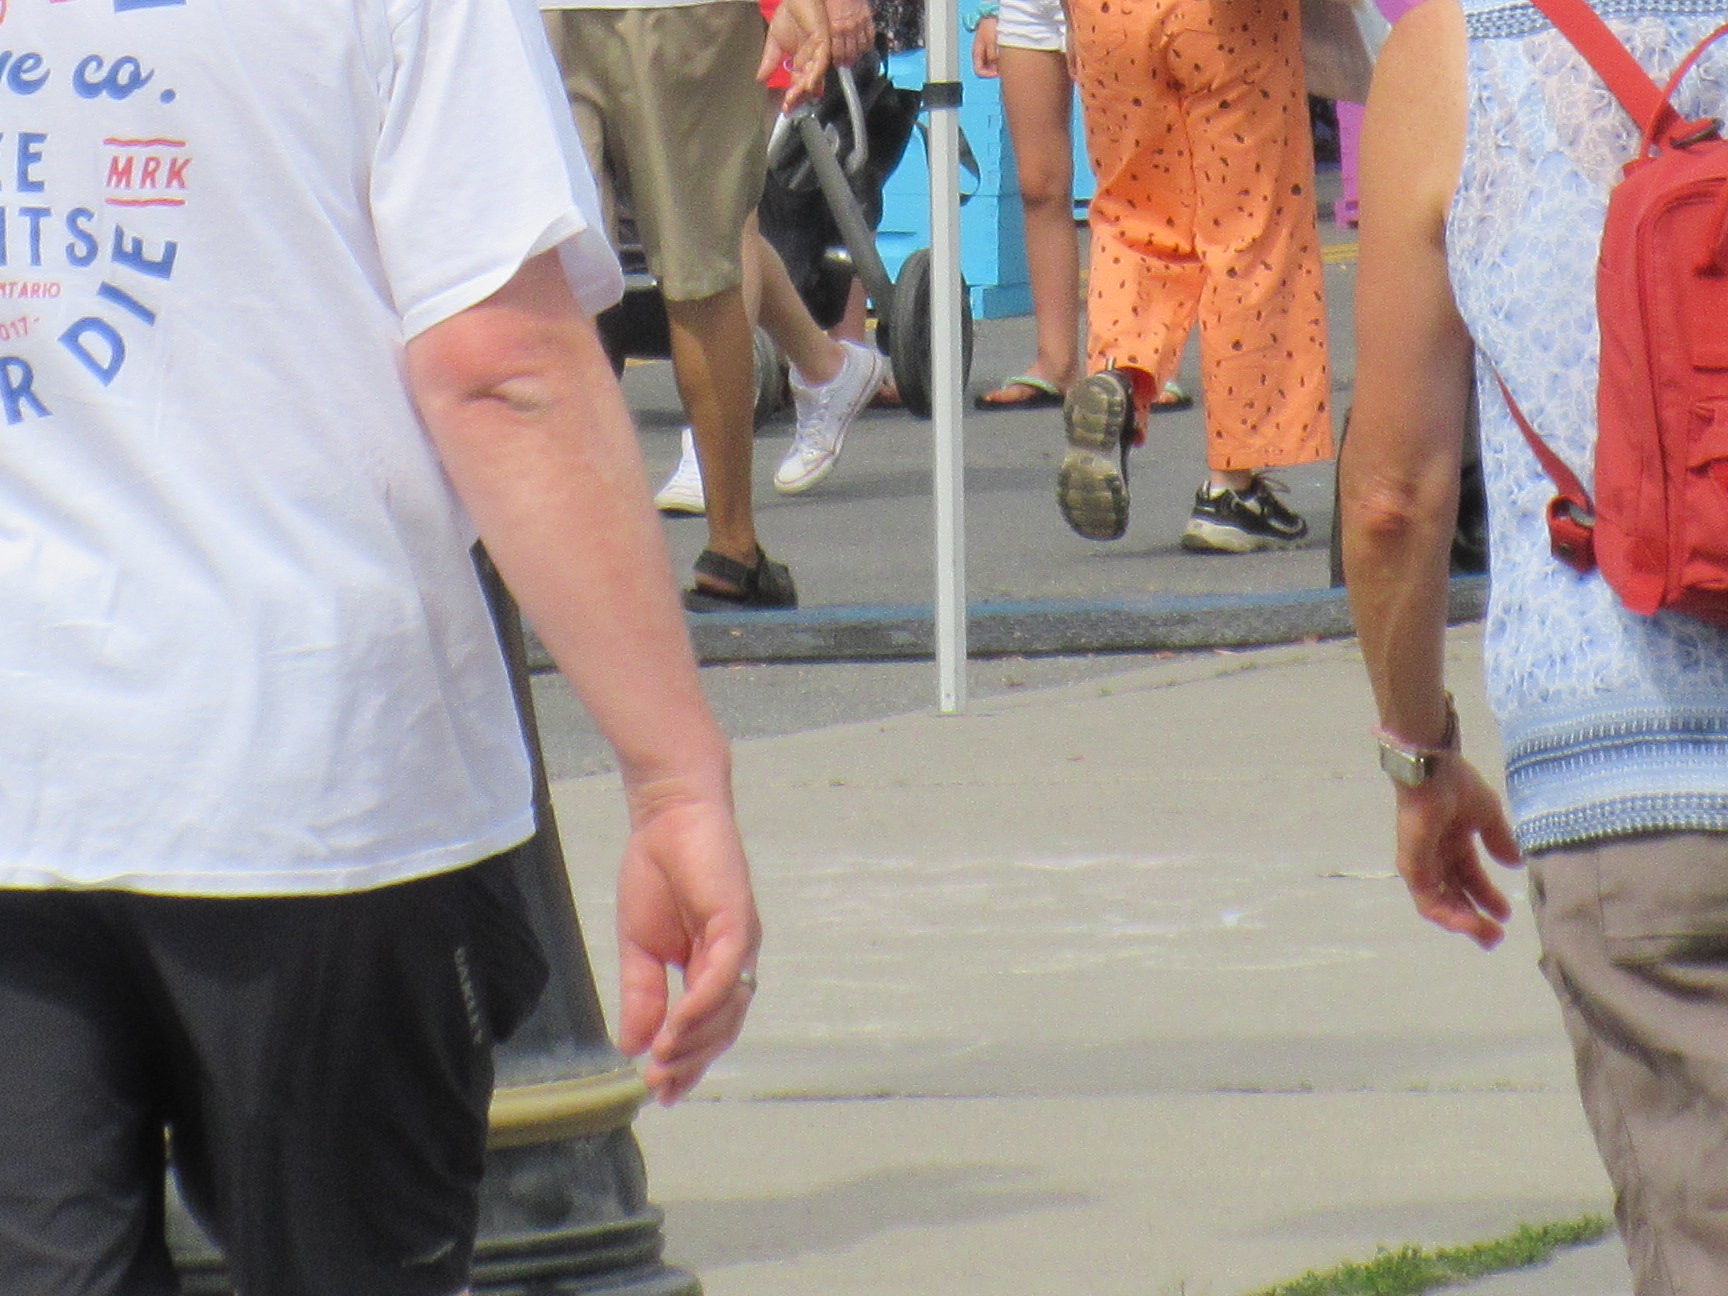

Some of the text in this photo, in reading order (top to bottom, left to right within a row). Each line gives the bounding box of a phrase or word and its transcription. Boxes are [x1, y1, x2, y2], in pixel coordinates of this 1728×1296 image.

[72, 54, 176, 105] co.
[105, 155, 192, 192] MRK
[57, 224, 180, 388] DIE
